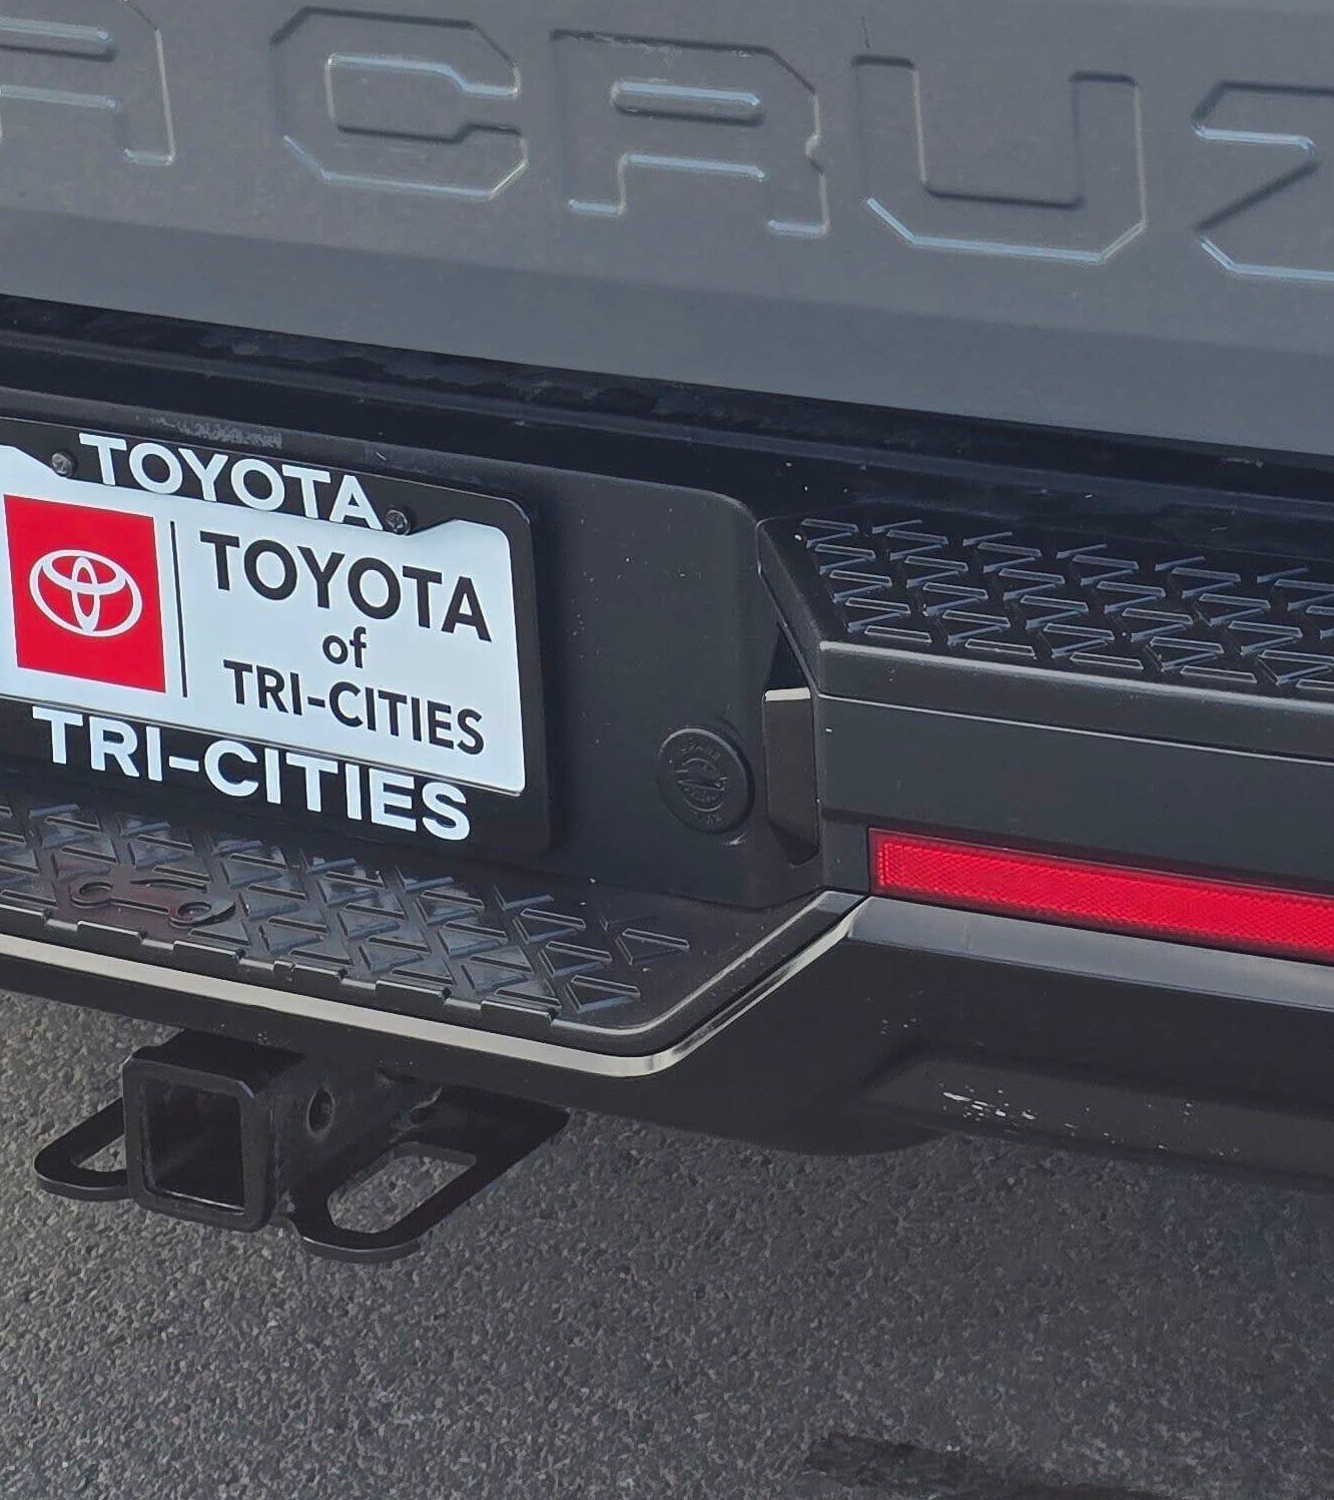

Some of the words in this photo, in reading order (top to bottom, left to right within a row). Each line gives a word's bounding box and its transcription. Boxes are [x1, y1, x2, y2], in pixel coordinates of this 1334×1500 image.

[78, 433, 384, 531] TOYOTA
[198, 530, 493, 643] TOYOTA
[322, 626, 367, 669] of
[222, 659, 485, 756] TRI-CITIES
[31, 706, 471, 842] TRI-CITIES
